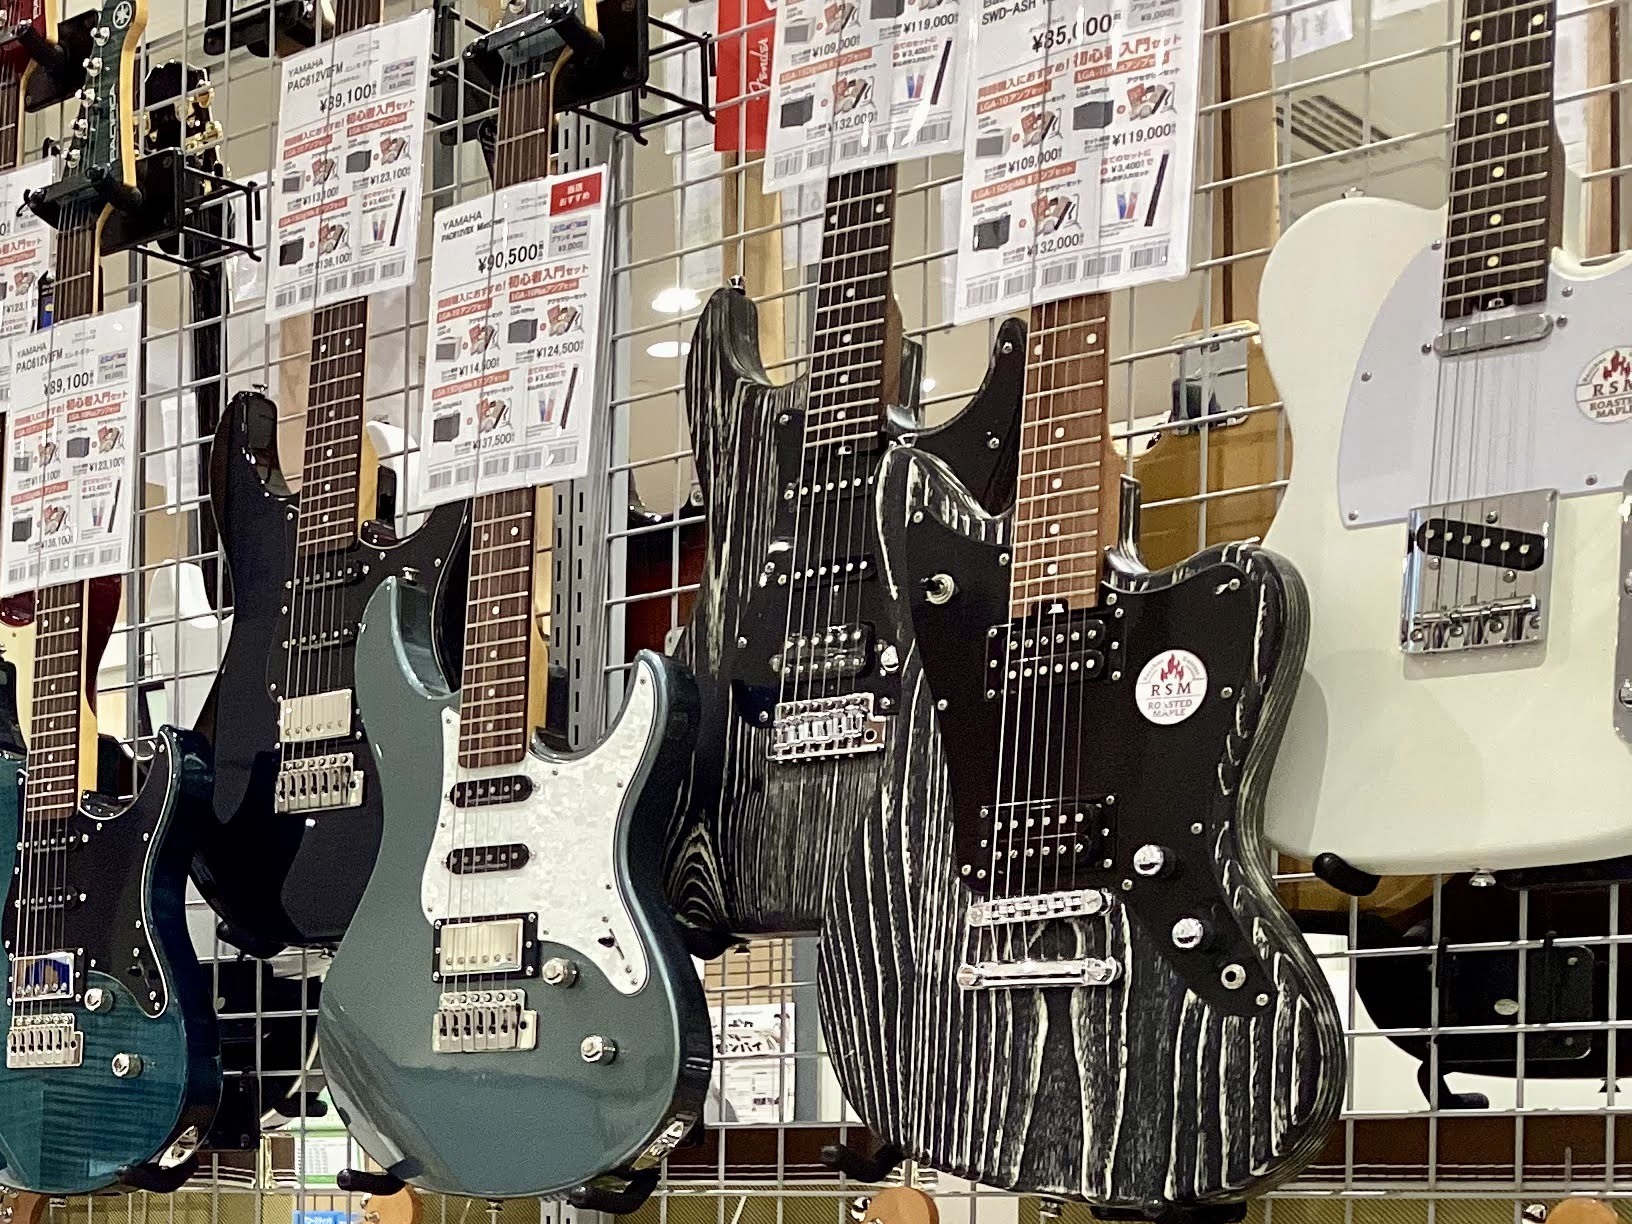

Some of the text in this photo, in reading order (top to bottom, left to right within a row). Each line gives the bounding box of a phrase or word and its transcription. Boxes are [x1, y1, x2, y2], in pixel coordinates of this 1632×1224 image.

[903, 13, 955, 34] ¥119,000
[289, 58, 323, 77] YAMAHA
[1112, 124, 1171, 147] ¥119,000
[1008, 149, 1060, 174] ¥109,000
[443, 210, 482, 230] YAMAHA
[1027, 233, 1081, 257] ¥132,000
[478, 244, 538, 273] ¥90,500
[536, 342, 580, 358] ¥124,500
[1590, 397, 1632, 411] ROAST
[1151, 682, 1191, 696] RSM
